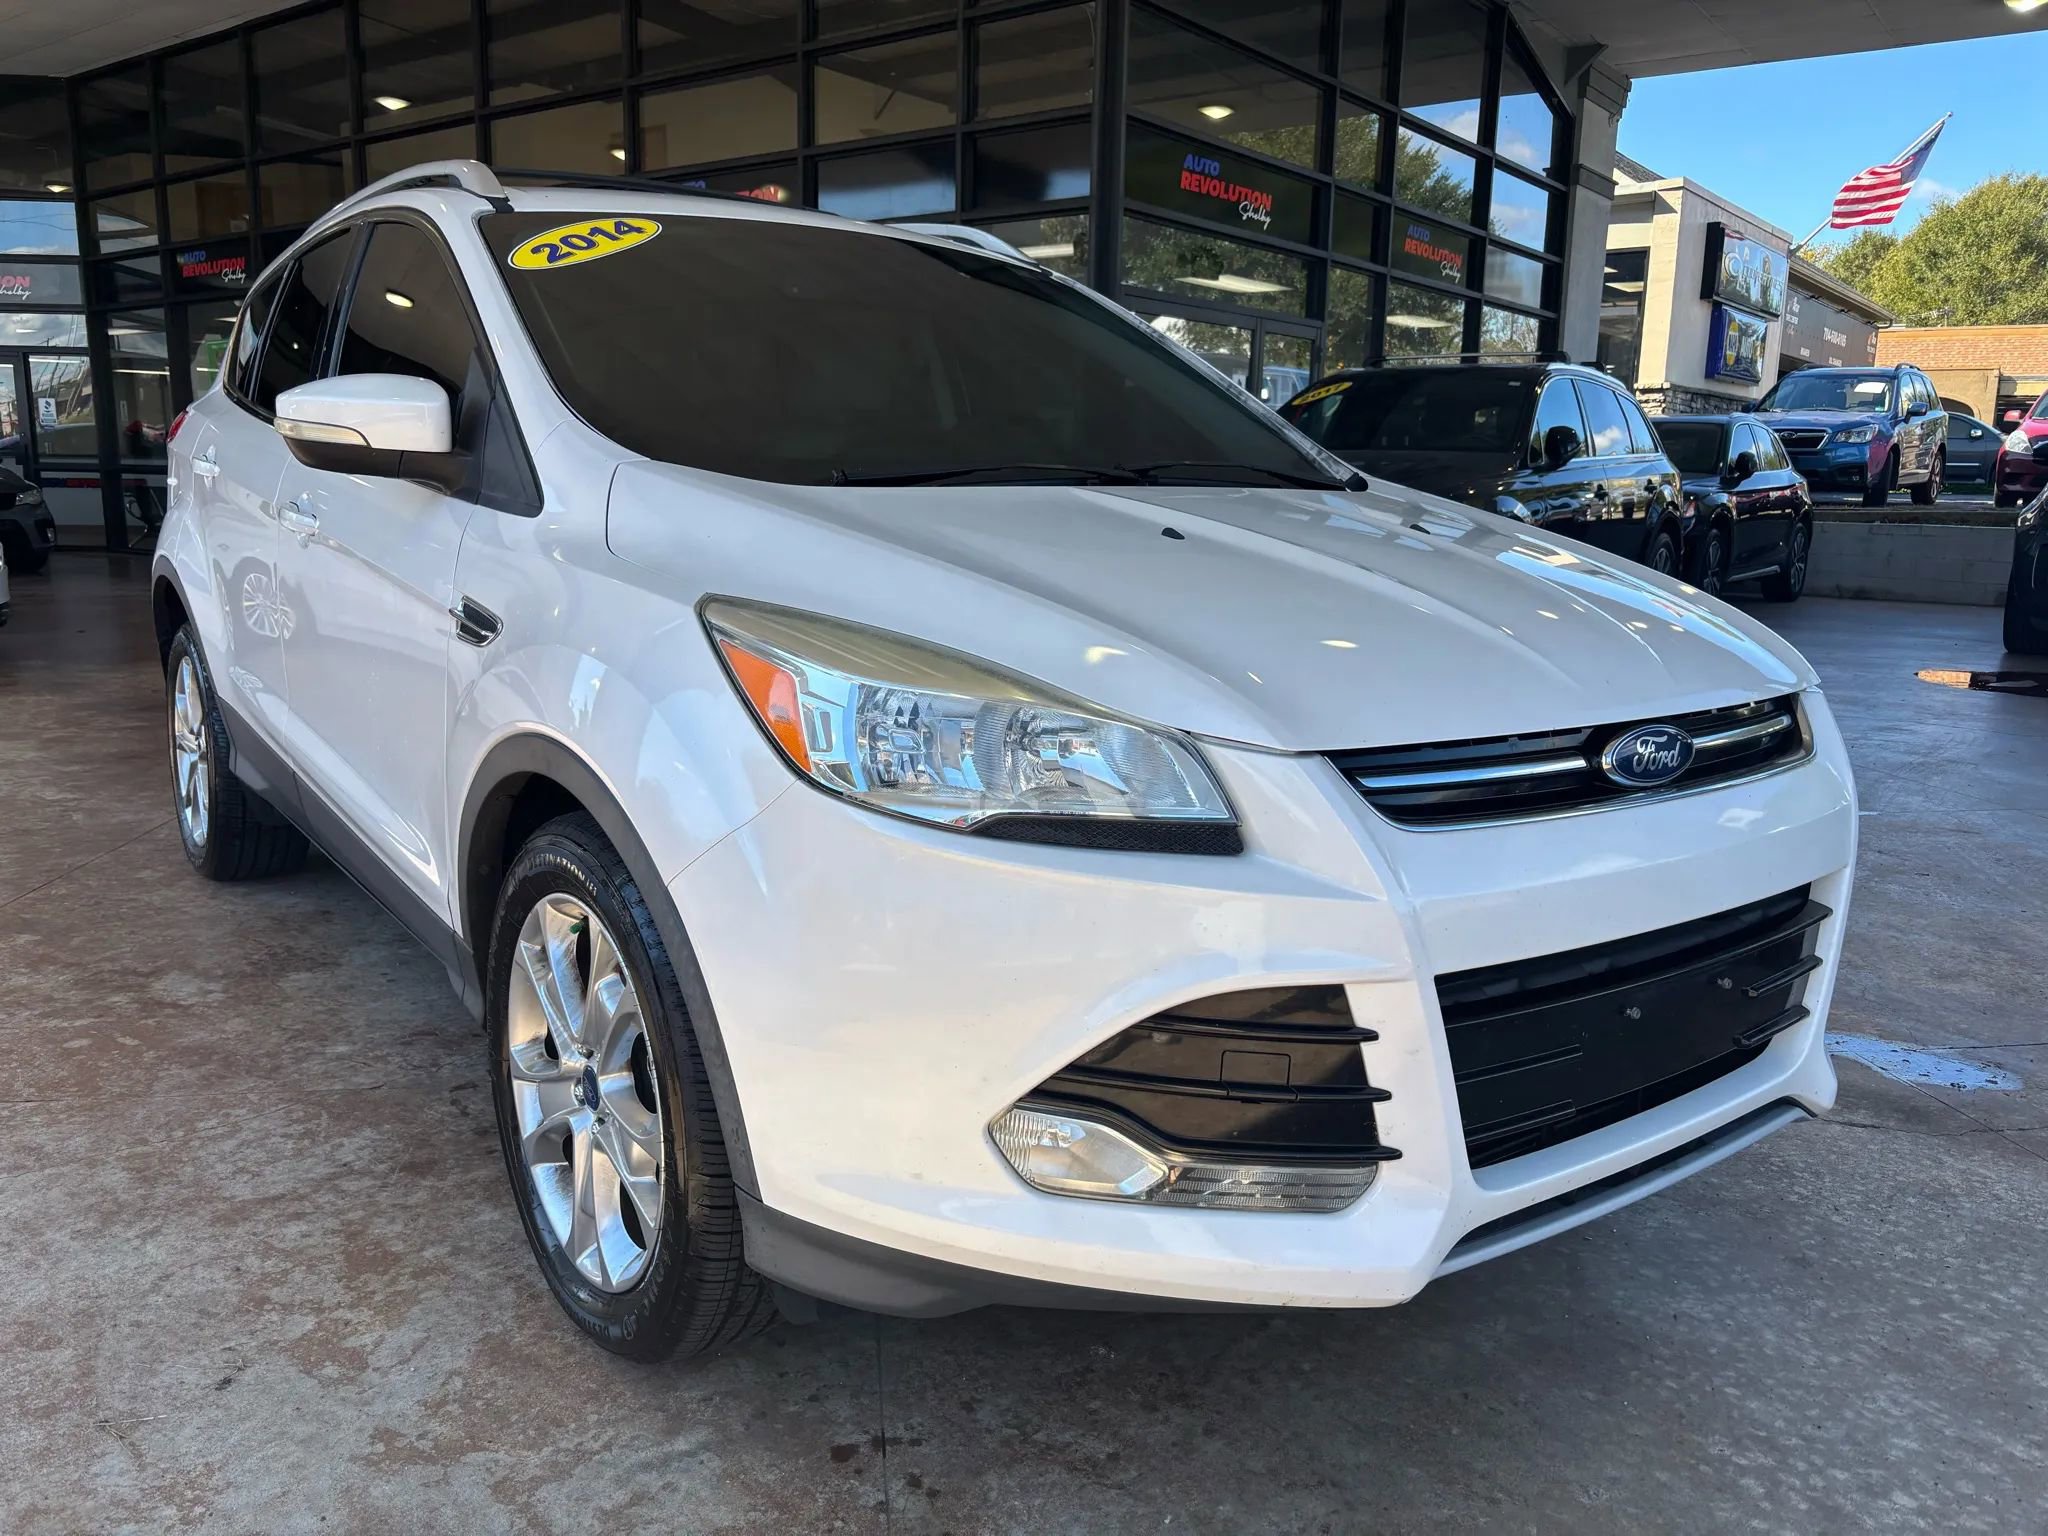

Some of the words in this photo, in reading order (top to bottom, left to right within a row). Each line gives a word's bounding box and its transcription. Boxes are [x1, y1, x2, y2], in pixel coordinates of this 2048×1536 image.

[1183, 153, 1220, 176] AUTO
[1180, 170, 1273, 211] REVOLUTION
[1238, 201, 1272, 230] Shelby
[530, 220, 645, 264] 2014
[1407, 224, 1430, 241] AUTO
[1404, 237, 1463, 268] REVOLUTION
[182, 257, 245, 278] REVOLUTION
[0, 283, 31, 300] helby
[1633, 734, 1681, 773] Ford
